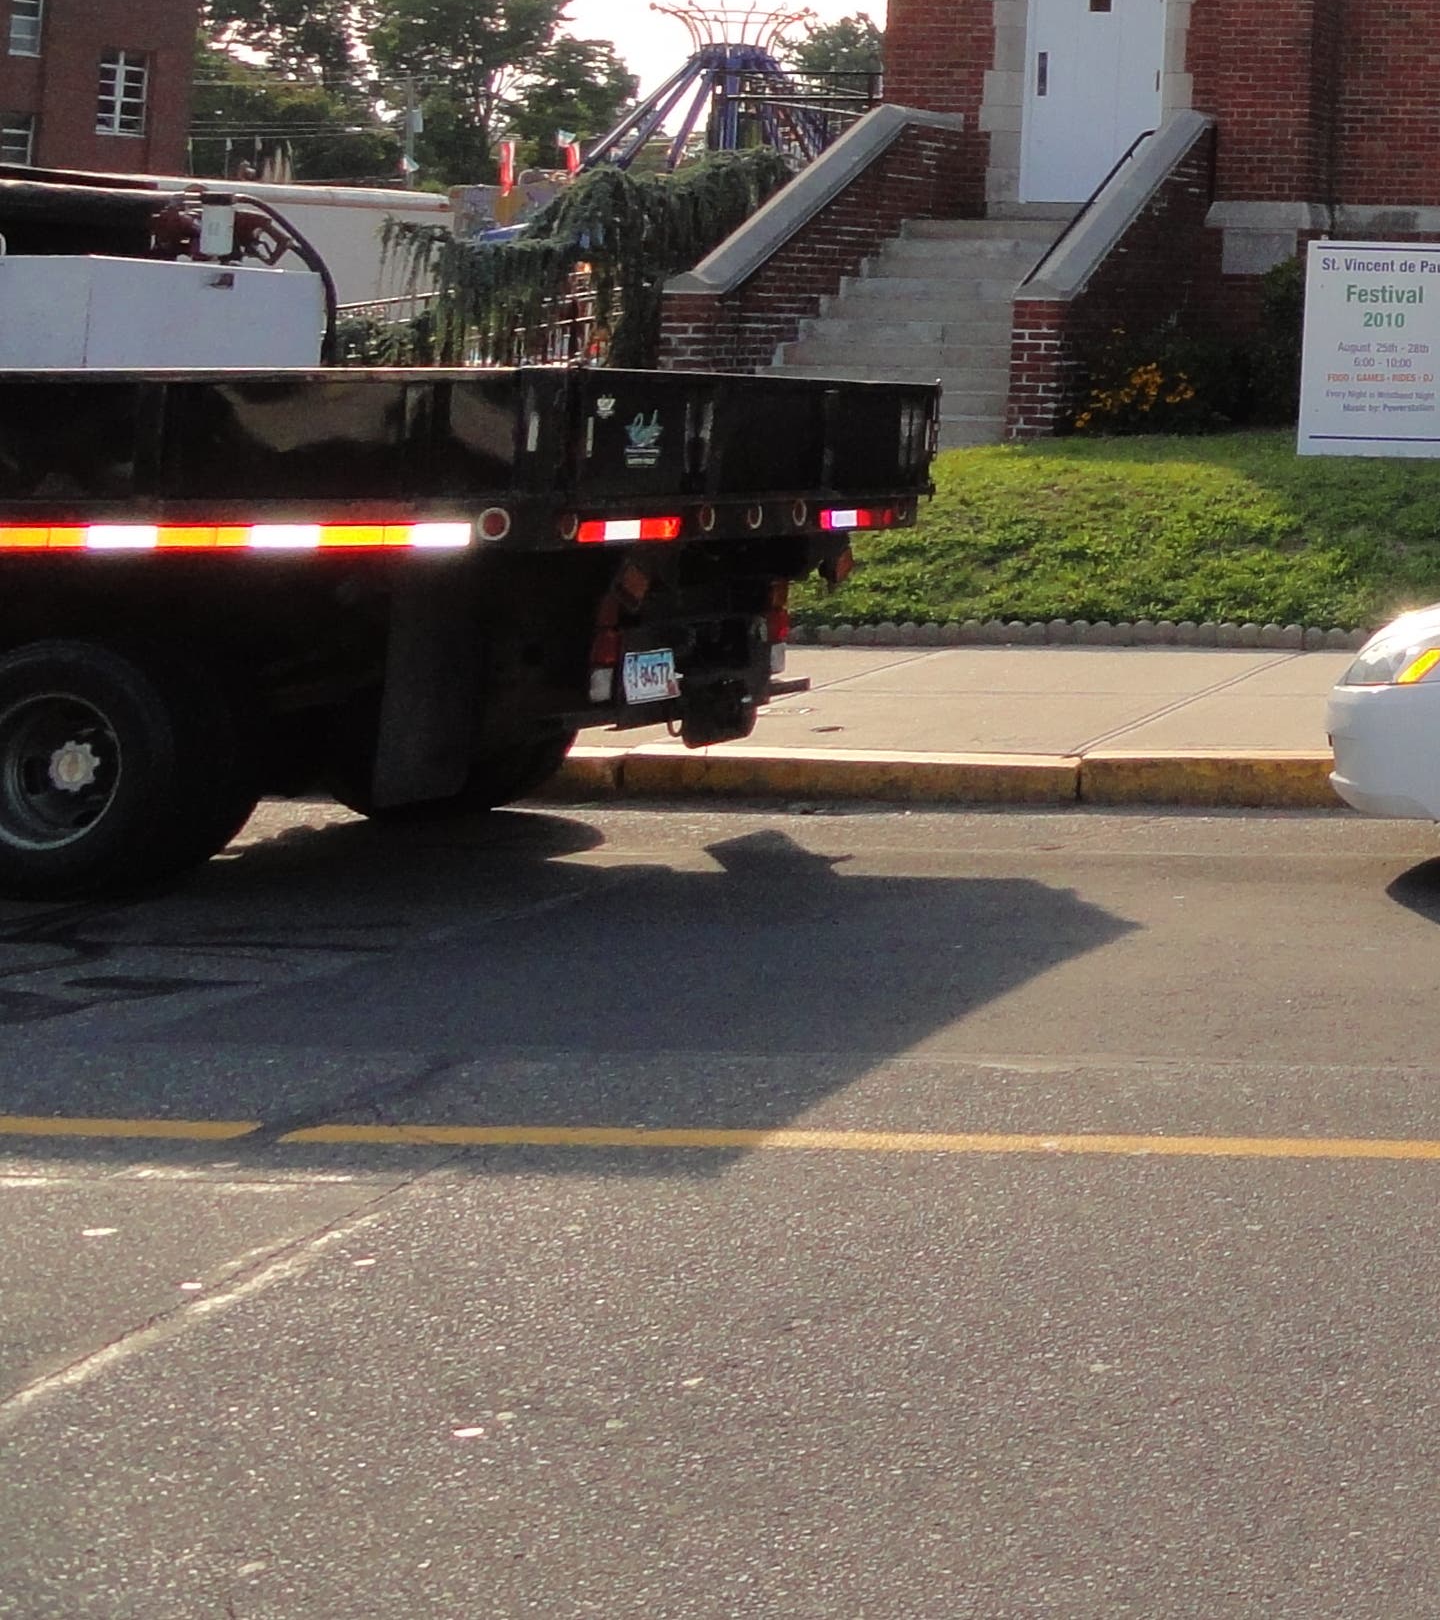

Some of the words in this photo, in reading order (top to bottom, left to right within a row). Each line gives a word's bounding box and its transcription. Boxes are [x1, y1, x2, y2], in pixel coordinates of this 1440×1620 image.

[1322, 257, 1340, 271] St.
[1345, 258, 1395, 272] Vincent
[1400, 260, 1415, 273] de
[1346, 284, 1424, 304] Festival
[1363, 312, 1405, 328] 2010
[1337, 341, 1371, 354] August
[1376, 342, 1398, 353] 25th
[1407, 343, 1430, 354] 28th
[1353, 358, 1375, 368] 6:00
[1386, 358, 1412, 368] 10:00
[1327, 373, 1349, 383] FOOD
[1356, 373, 1385, 383] GAMES
[1391, 374, 1415, 383] RIDES
